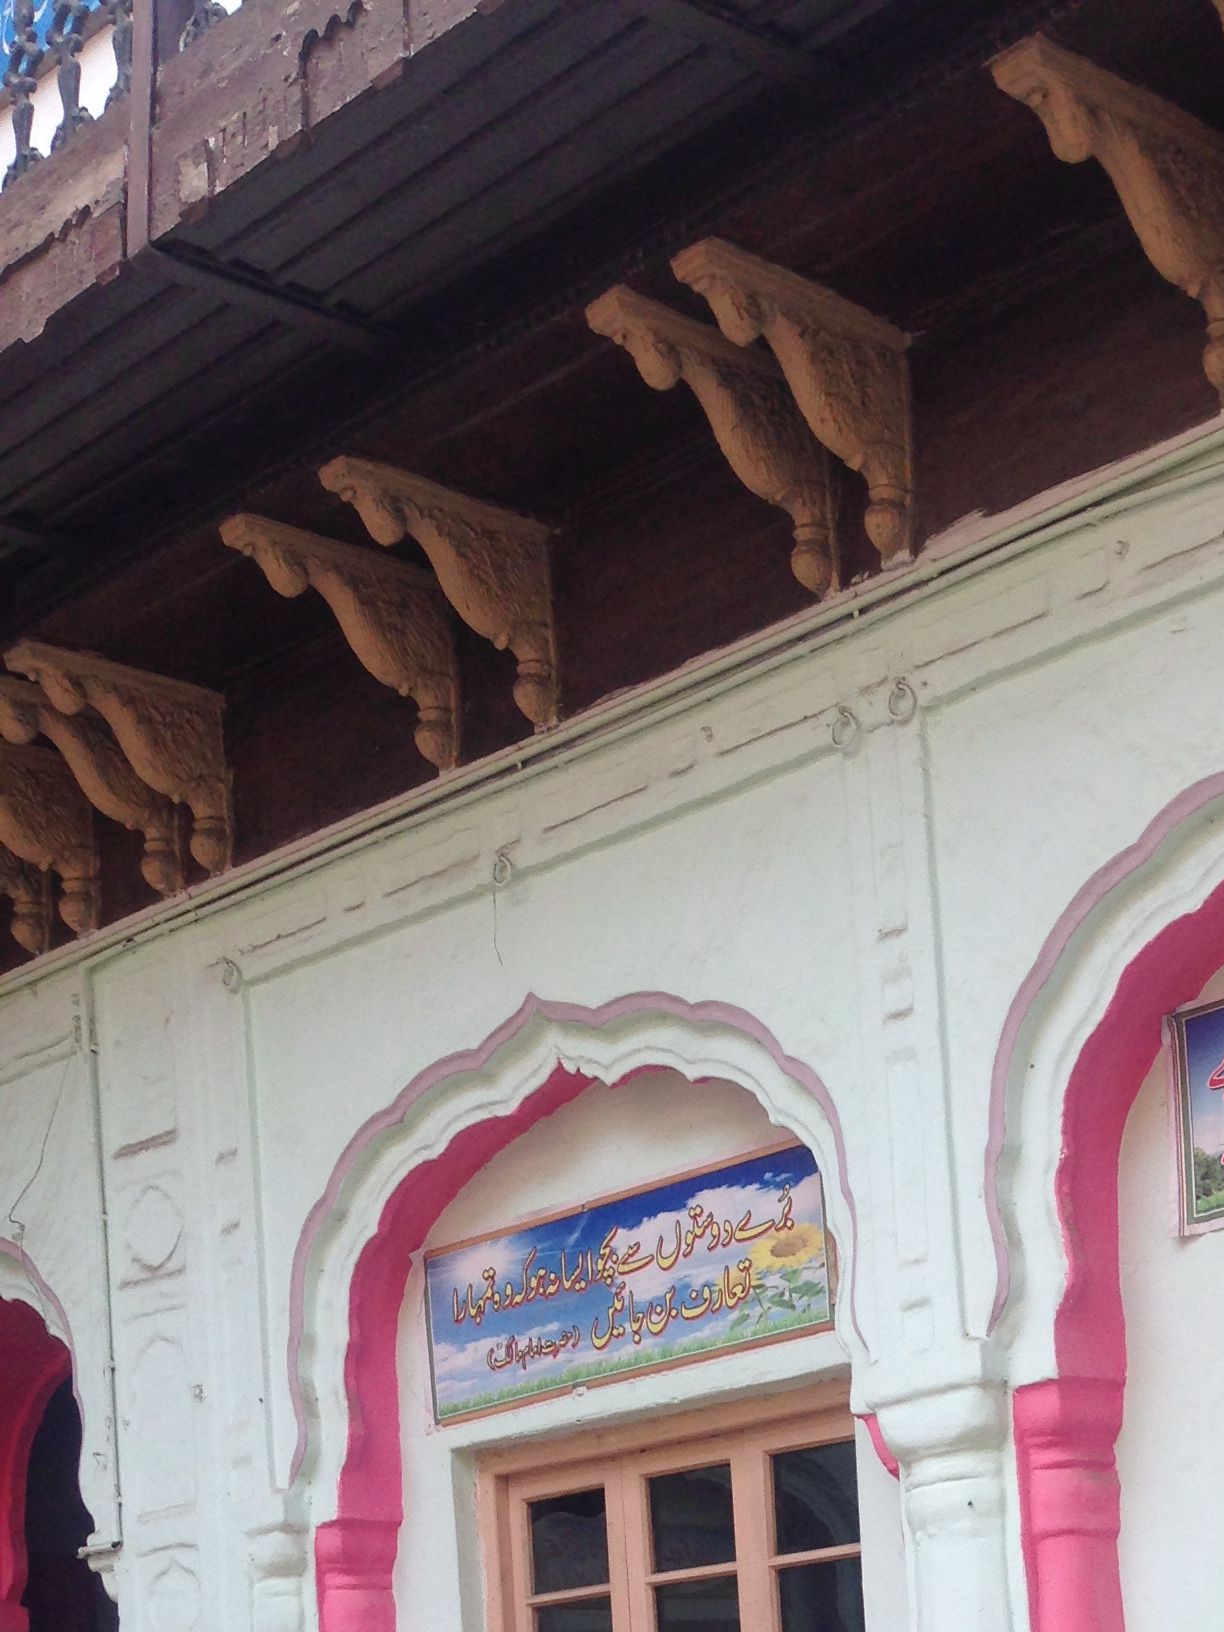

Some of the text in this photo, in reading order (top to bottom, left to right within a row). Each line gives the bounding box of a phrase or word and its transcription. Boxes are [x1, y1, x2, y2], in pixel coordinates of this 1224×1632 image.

[595, 1226, 619, 1286] بچو
[617, 1241, 655, 1275] سے
[656, 1204, 733, 1270] دوستوں
[512, 1246, 538, 1306] کہ
[527, 1267, 547, 1300] ہو
[545, 1271, 560, 1297] نہ
[561, 1248, 593, 1291] ایسا
[453, 1267, 496, 1325] تمہارا
[493, 1281, 512, 1312] وہ
[591, 1257, 752, 1350] تعارف بن جائیں
